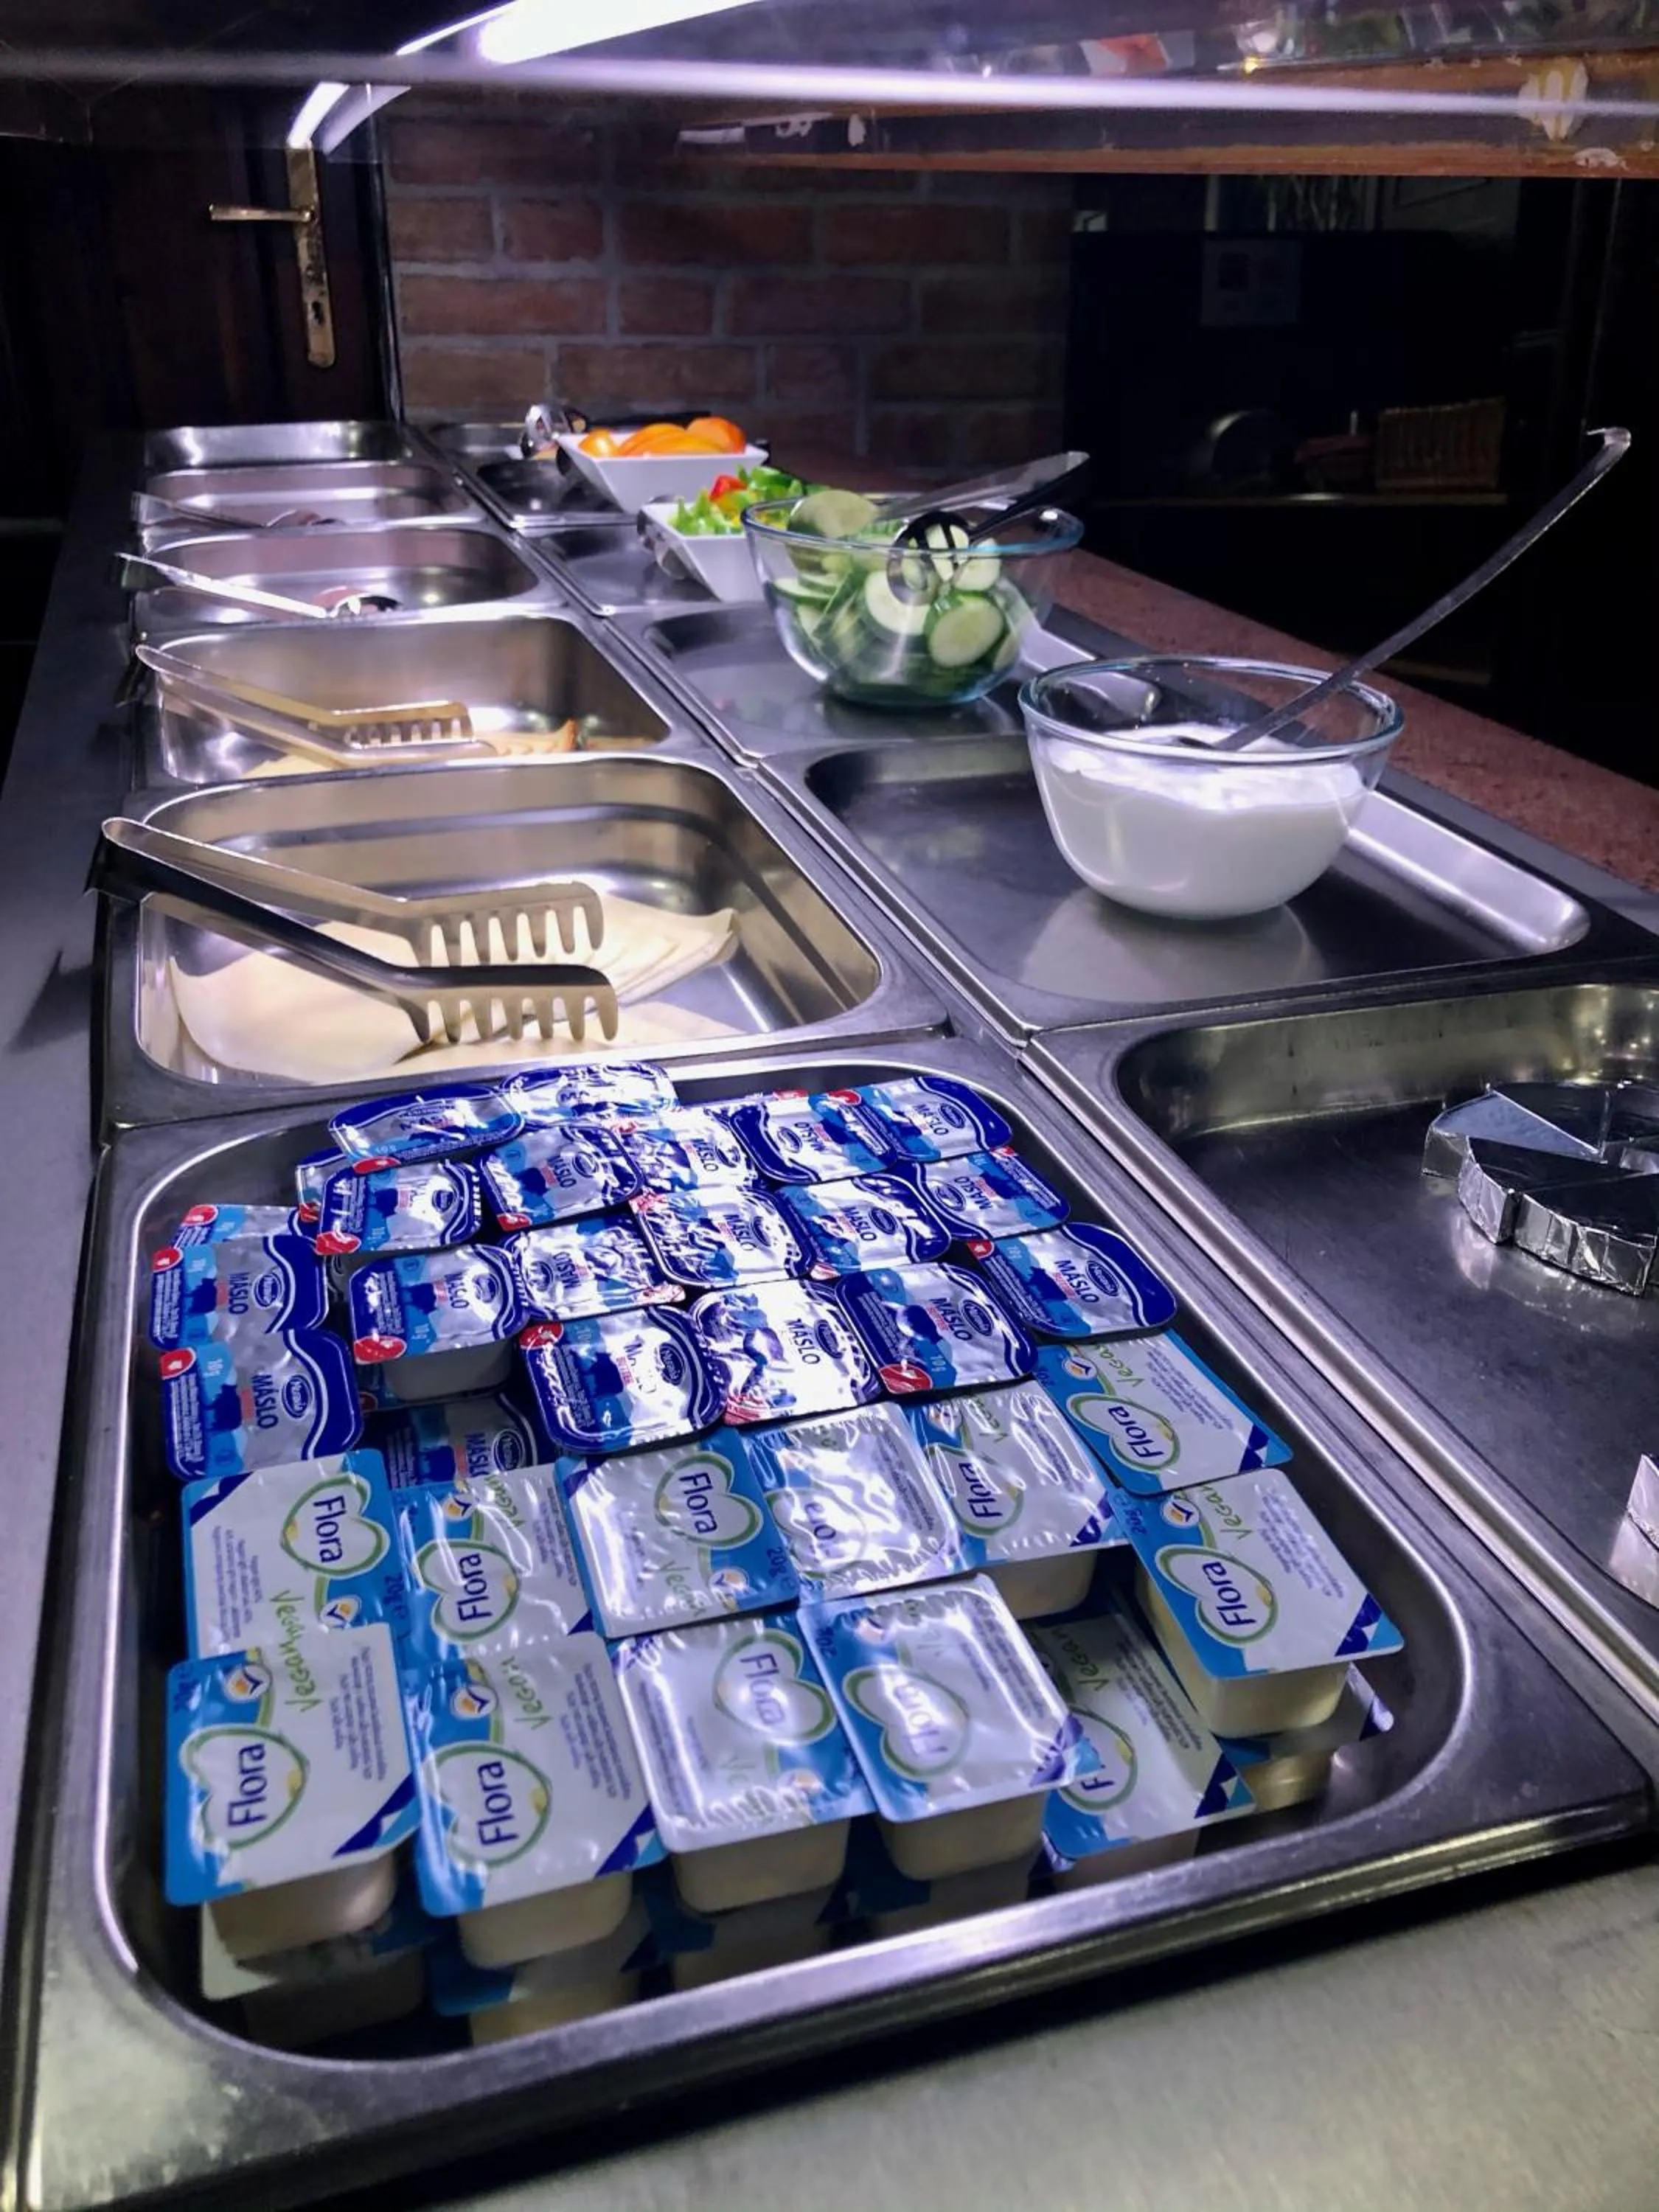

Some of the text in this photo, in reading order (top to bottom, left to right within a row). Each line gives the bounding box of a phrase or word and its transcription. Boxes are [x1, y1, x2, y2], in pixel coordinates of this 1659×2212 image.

[954, 1177, 992, 1210] MÁSLO
[841, 1207, 877, 1241] MÁSLO
[229, 1272, 250, 1315] MÁSLO
[1054, 1260, 1099, 1303] MÁSLO
[783, 1318, 821, 1365] MÁSLO
[929, 1298, 973, 1340] MÁSLO
[251, 1373, 280, 1429] MÁSLO
[466, 1433, 490, 1476] MÁSL
[1107, 1405, 1164, 1458] Flora
[678, 1472, 718, 1534] Flora
[959, 1461, 1004, 1518] Flora
[313, 1495, 347, 1563] Flora
[456, 1553, 494, 1621] Flora
[1202, 1561, 1256, 1627] Flora
[740, 1652, 786, 1725] Flora
[226, 1743, 268, 1829] Flora
[477, 1760, 519, 1847] Flora
